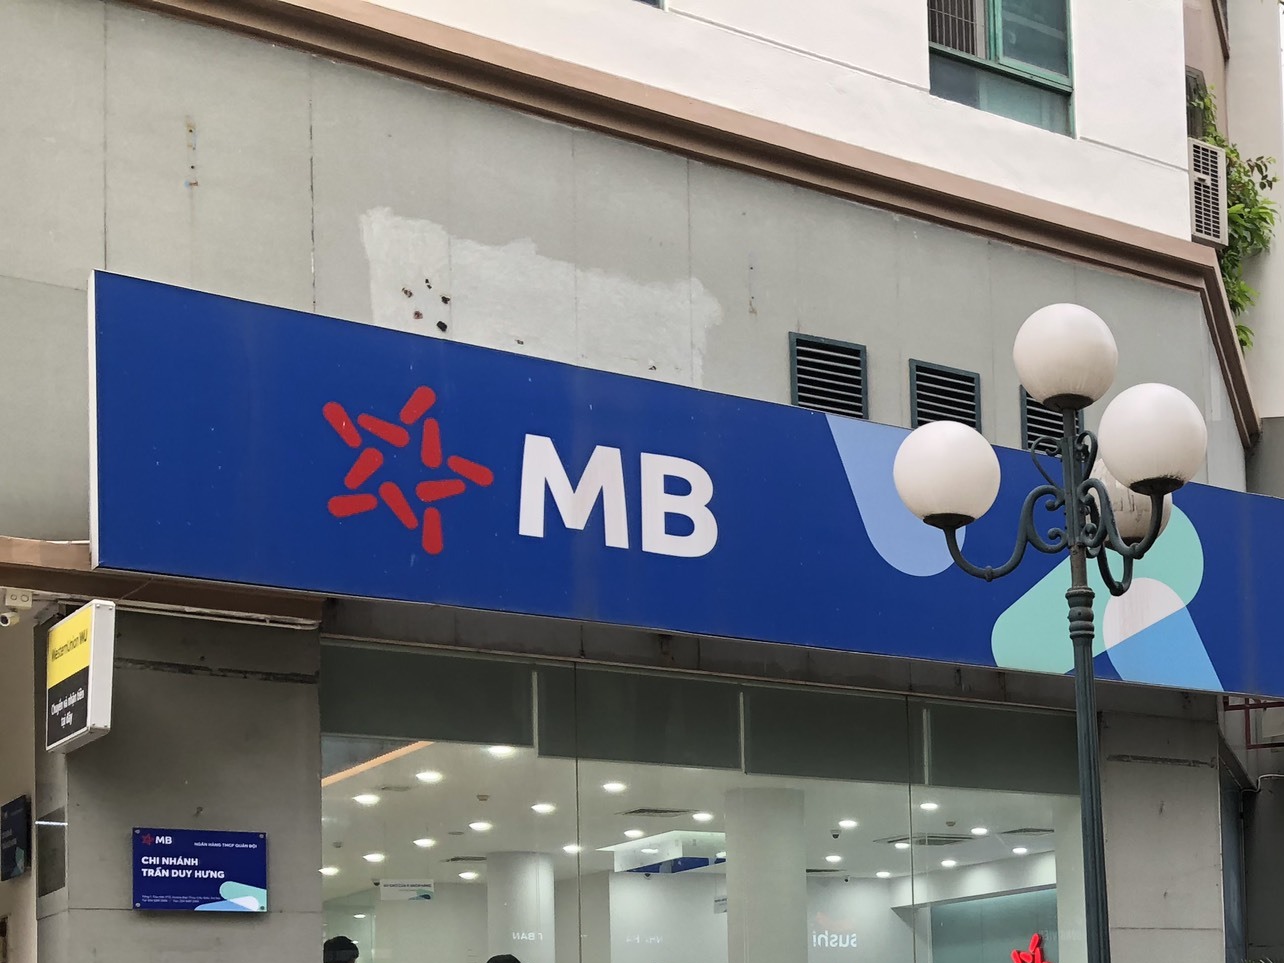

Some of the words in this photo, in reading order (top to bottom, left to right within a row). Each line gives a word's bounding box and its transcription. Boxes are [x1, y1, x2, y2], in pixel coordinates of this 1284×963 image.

[519, 434, 719, 558] MB
[155, 836, 172, 844] MB
[142, 856, 160, 865] CHI
[162, 856, 198, 866] NHÁNH
[172, 870, 193, 878] DUY
[194, 870, 225, 878] HƯNG
